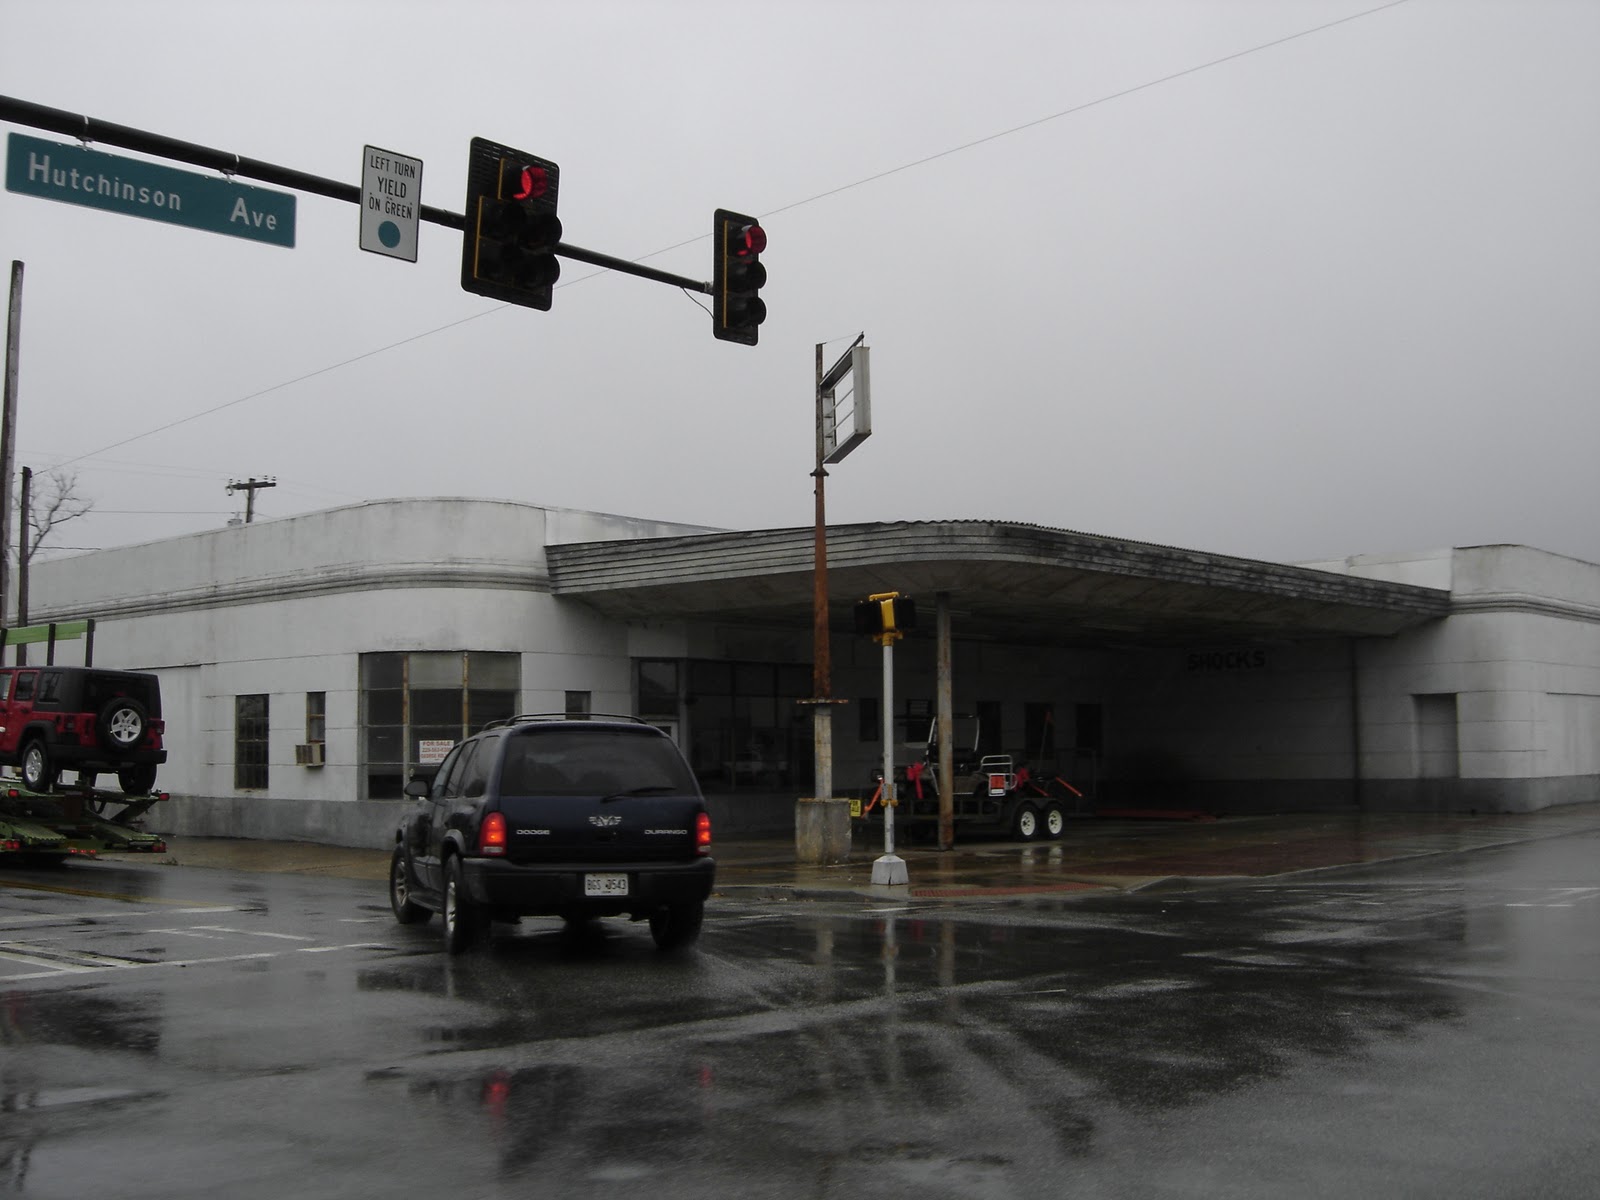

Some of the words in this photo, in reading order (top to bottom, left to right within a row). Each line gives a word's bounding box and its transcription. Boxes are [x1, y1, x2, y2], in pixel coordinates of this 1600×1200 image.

[370, 154, 391, 172] LEFT
[394, 160, 416, 179] TURN
[28, 151, 182, 211] Hutchinson
[229, 197, 277, 230] Ave
[377, 175, 407, 199] YIELD
[369, 196, 381, 212] ON
[385, 200, 413, 220] GREEN
[1187, 650, 1266, 671] SHOCKS
